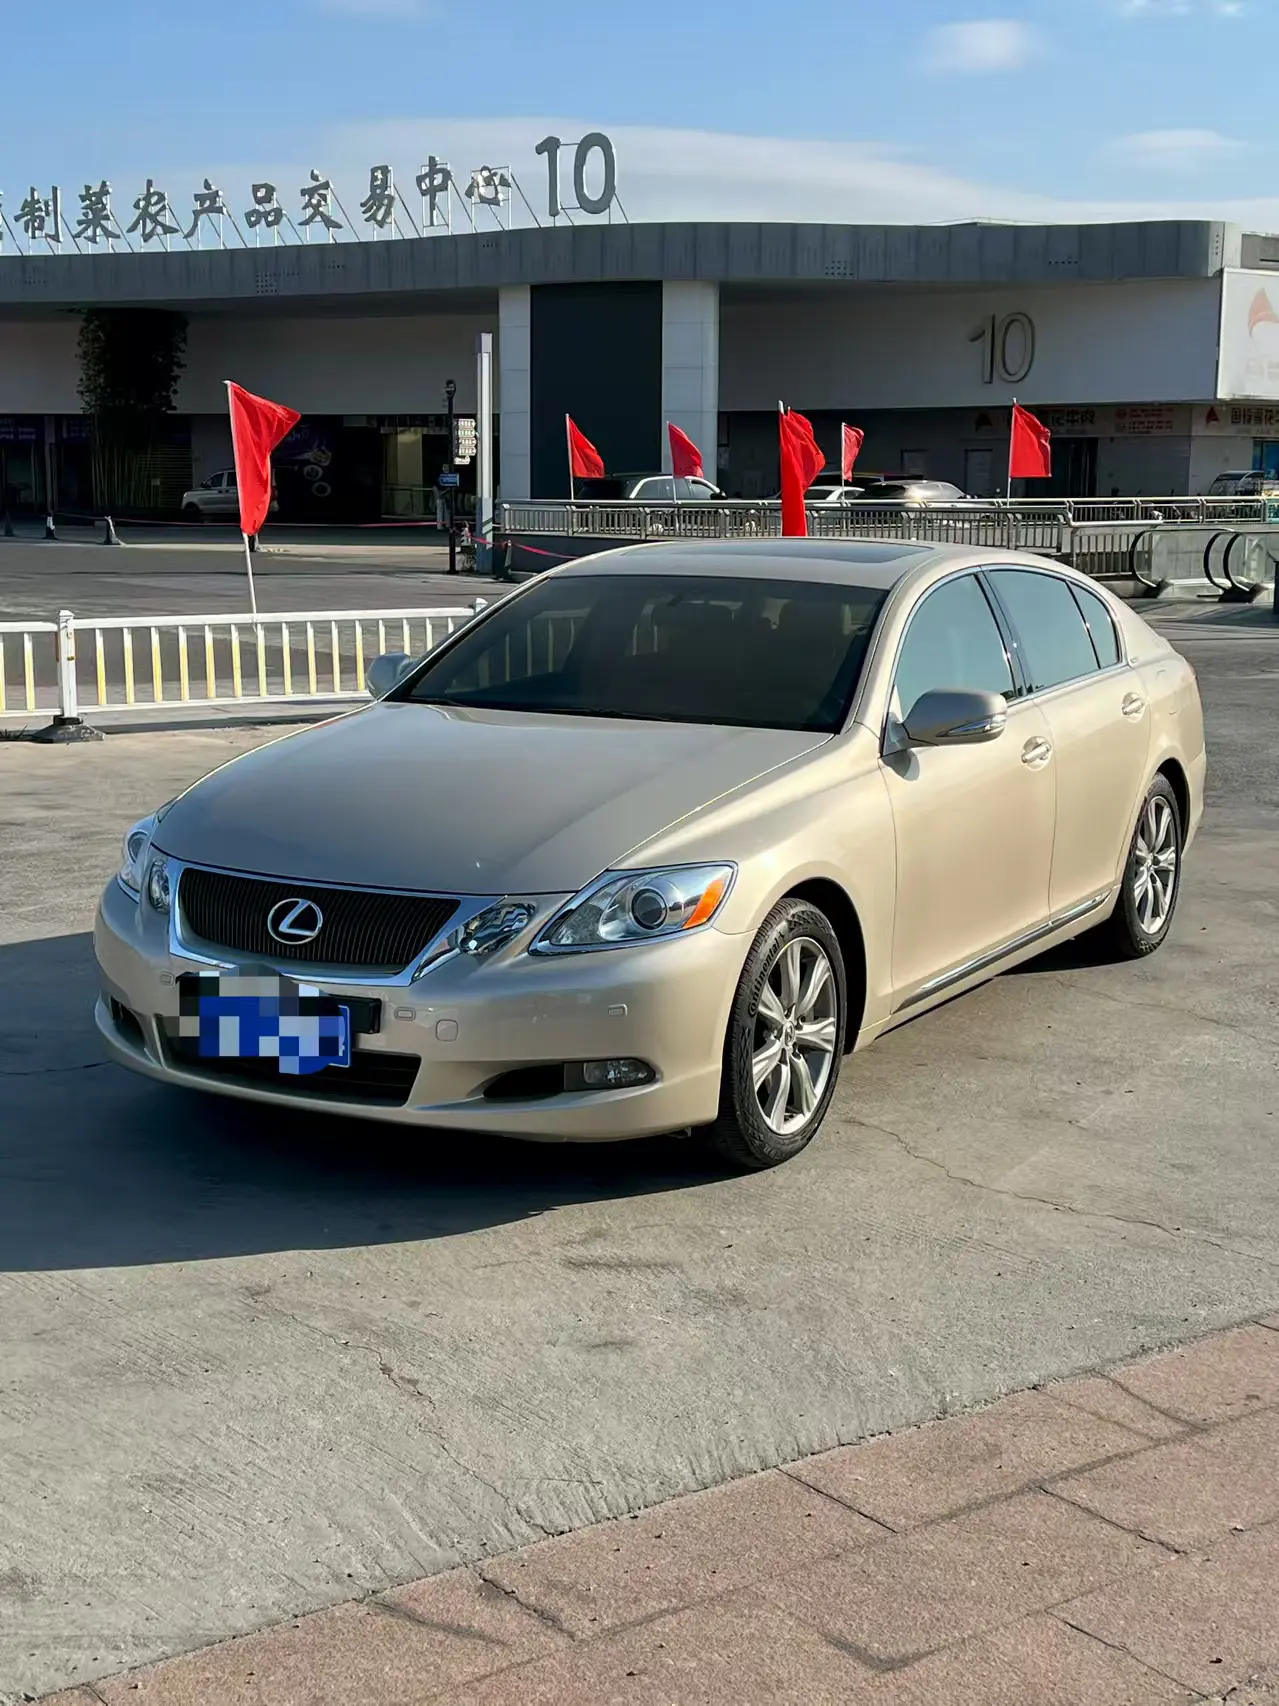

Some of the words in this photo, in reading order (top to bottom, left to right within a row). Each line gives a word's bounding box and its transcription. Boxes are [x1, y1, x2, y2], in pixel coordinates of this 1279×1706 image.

[0, 155, 512, 243] 制菜农产品交易中心
[535, 132, 616, 216] 10
[968, 312, 1036, 384] 10
[747, 937, 781, 1018] Continental
